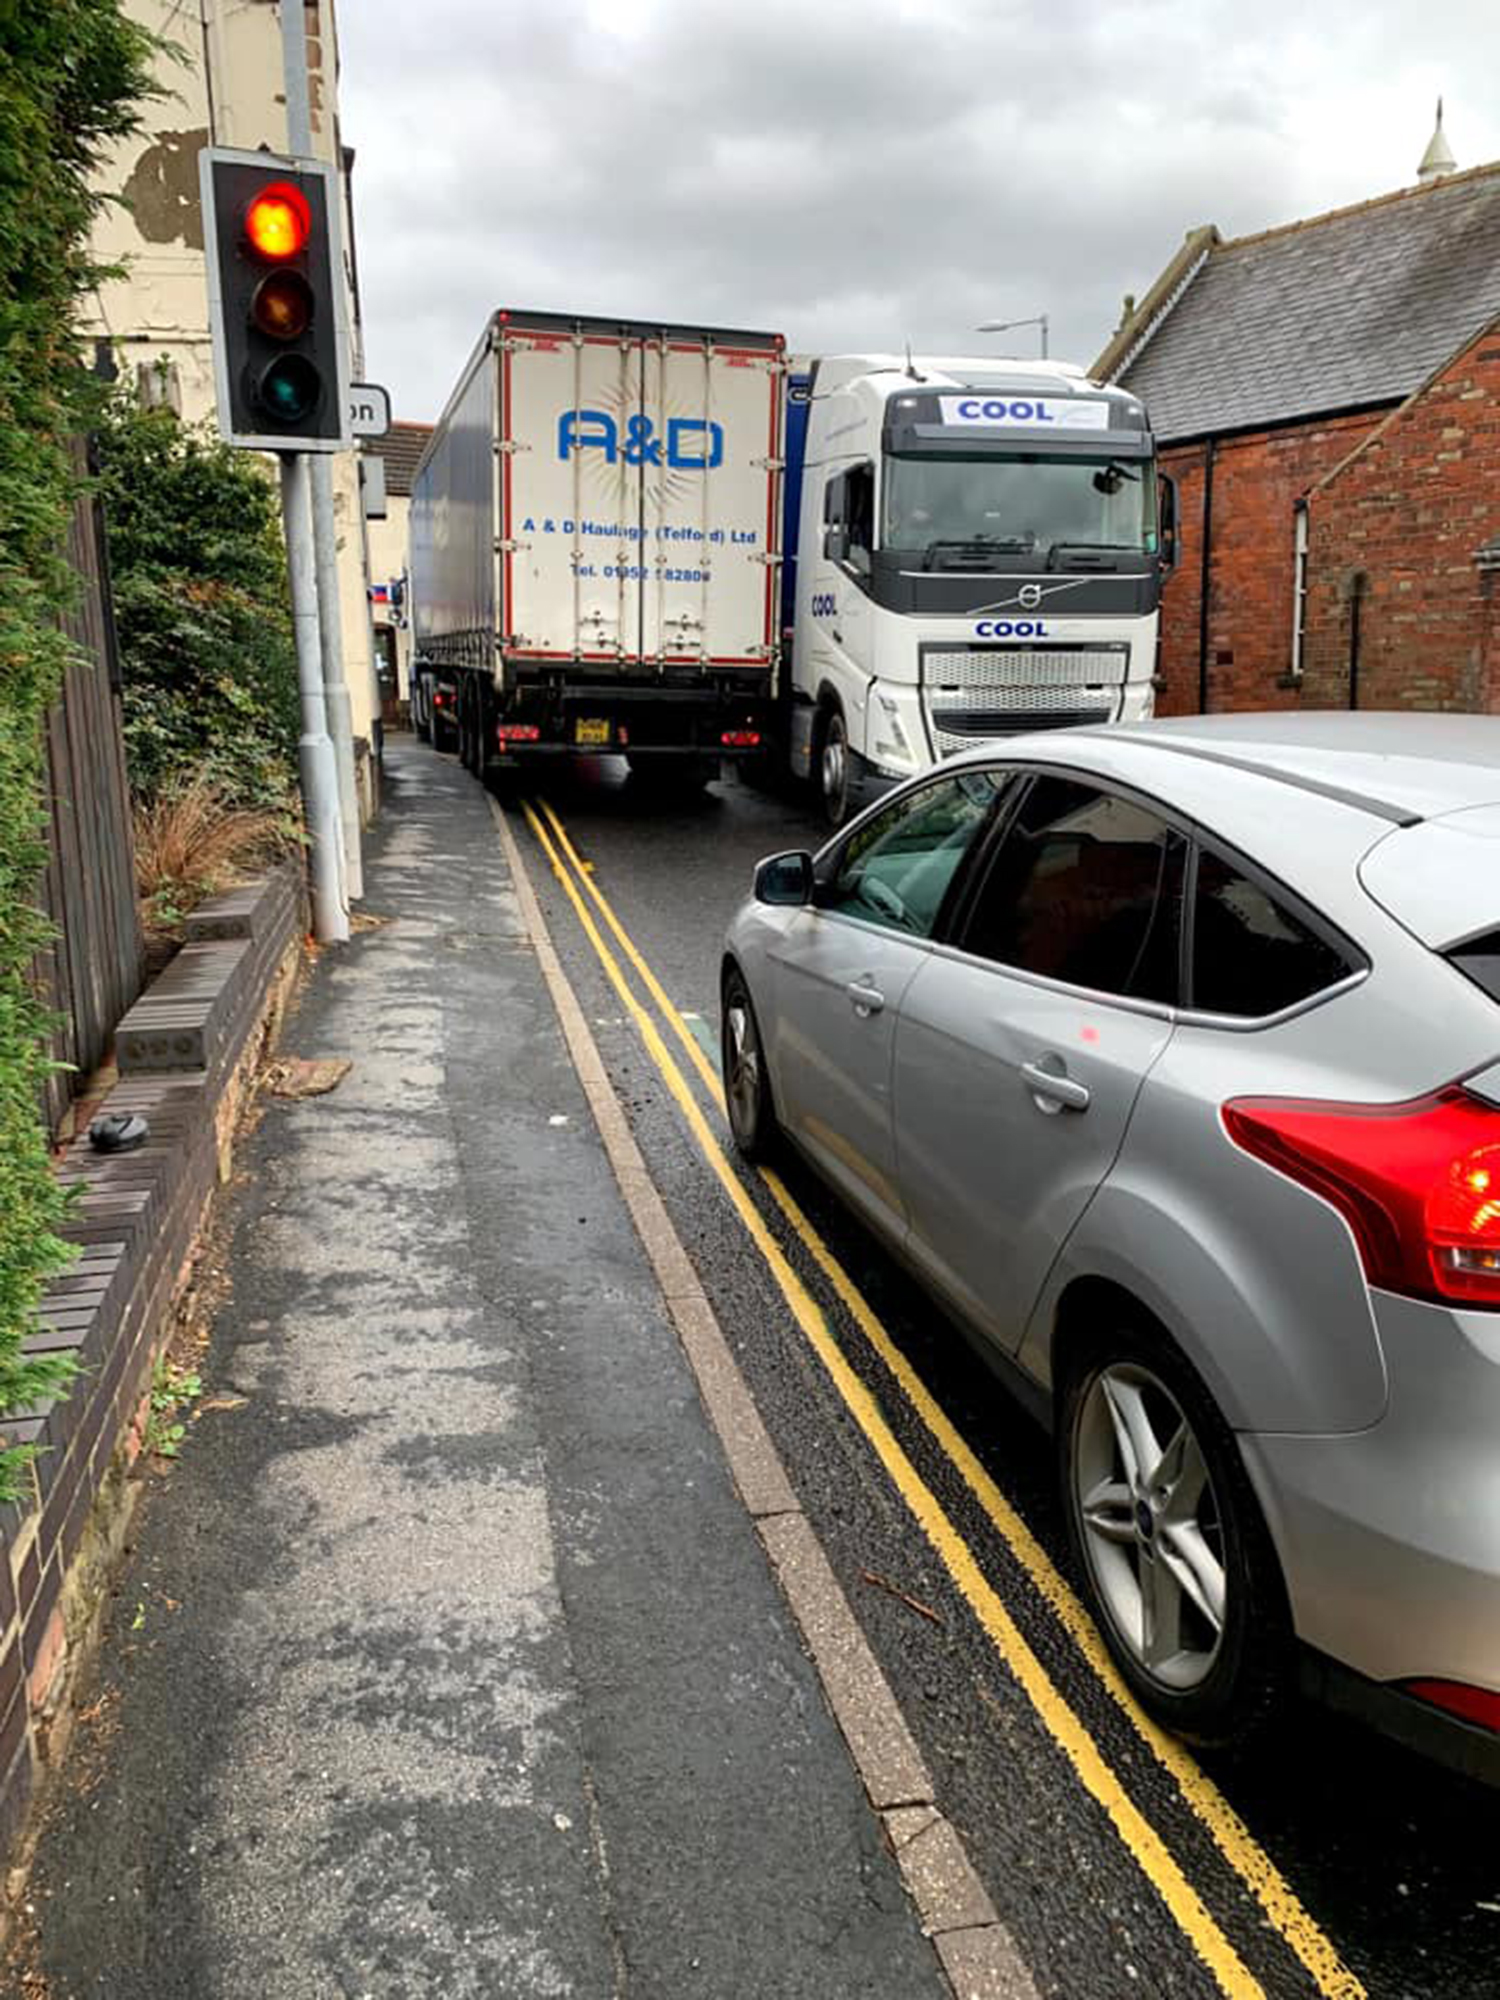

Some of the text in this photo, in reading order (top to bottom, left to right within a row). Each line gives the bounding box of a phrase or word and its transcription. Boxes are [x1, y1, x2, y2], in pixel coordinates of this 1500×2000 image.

[958, 400, 1054, 421] COOL
[558, 410, 723, 468] A&D
[523, 517, 535, 532] A
[543, 518, 555, 533] &
[562, 519, 575, 534] D
[655, 526, 724, 545] (Telfod)
[731, 529, 757, 543] Ltd
[975, 621, 1049, 637] COOL
